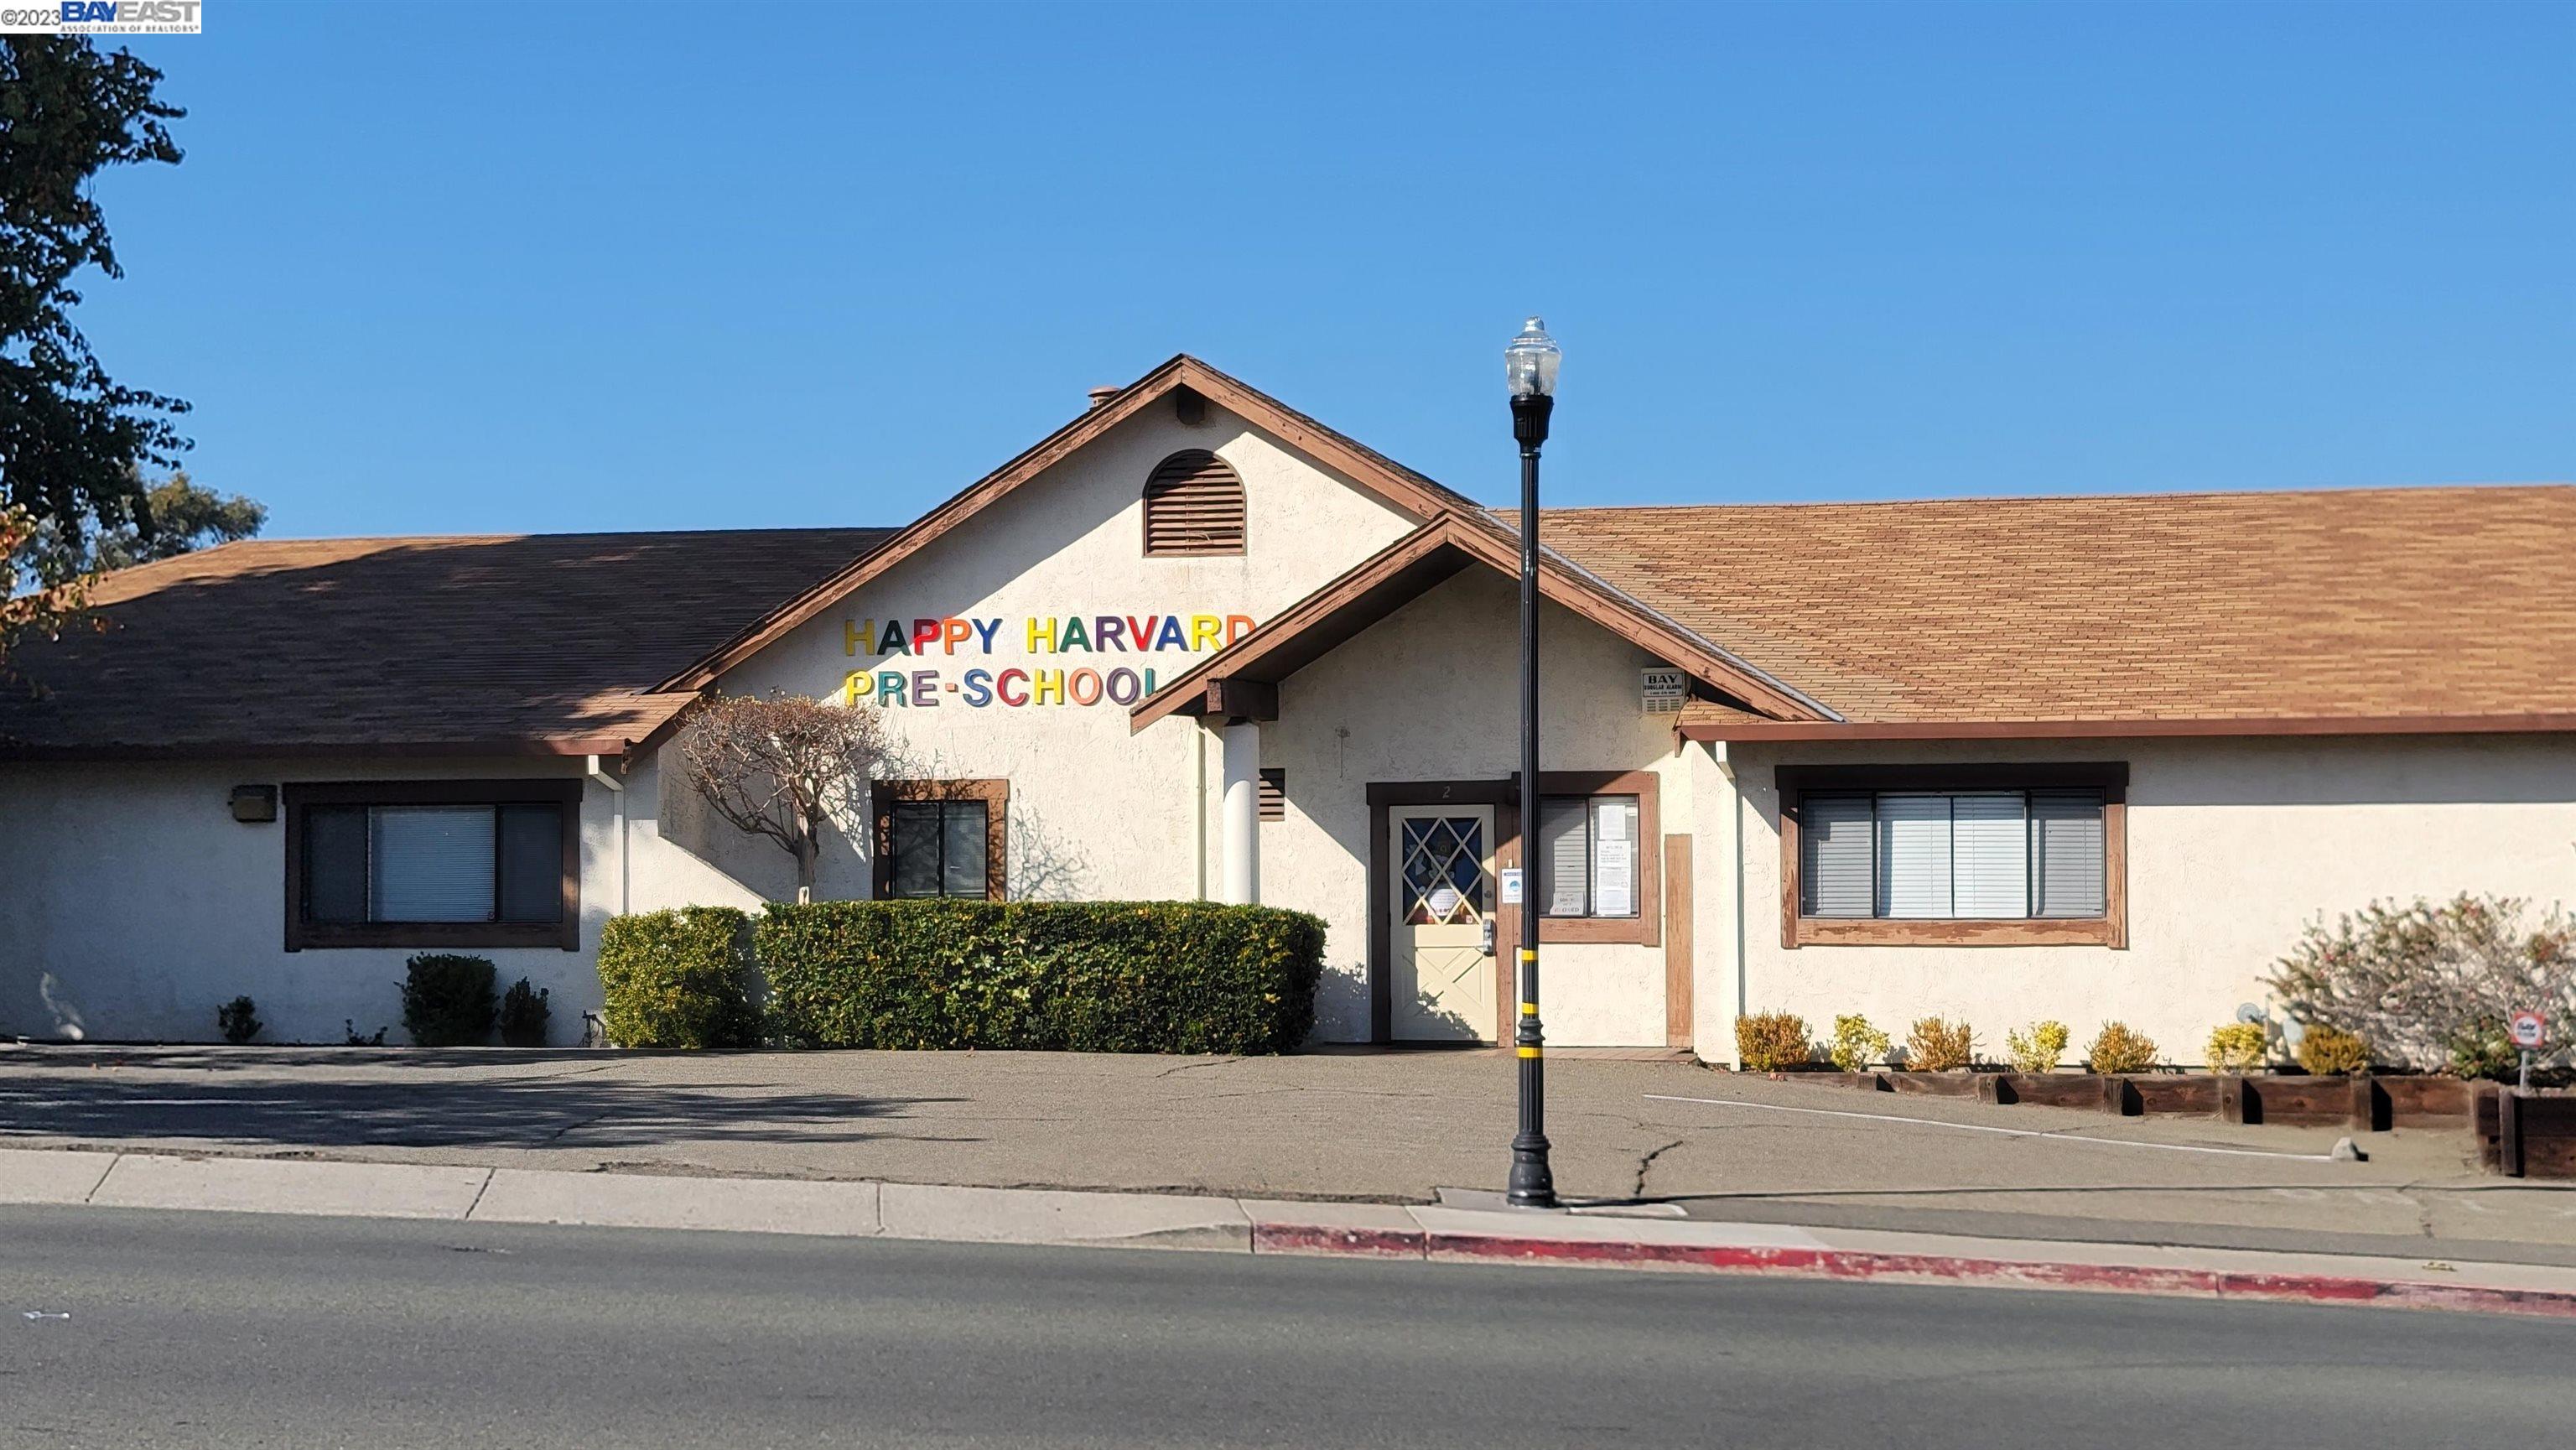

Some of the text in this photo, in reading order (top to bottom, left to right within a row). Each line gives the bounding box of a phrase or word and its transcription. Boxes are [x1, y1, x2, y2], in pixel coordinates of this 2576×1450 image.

[845, 615, 1257, 657] HAPPY HARVARD
[1649, 675, 1677, 683] BAY
[1442, 785, 1450, 798] 2
